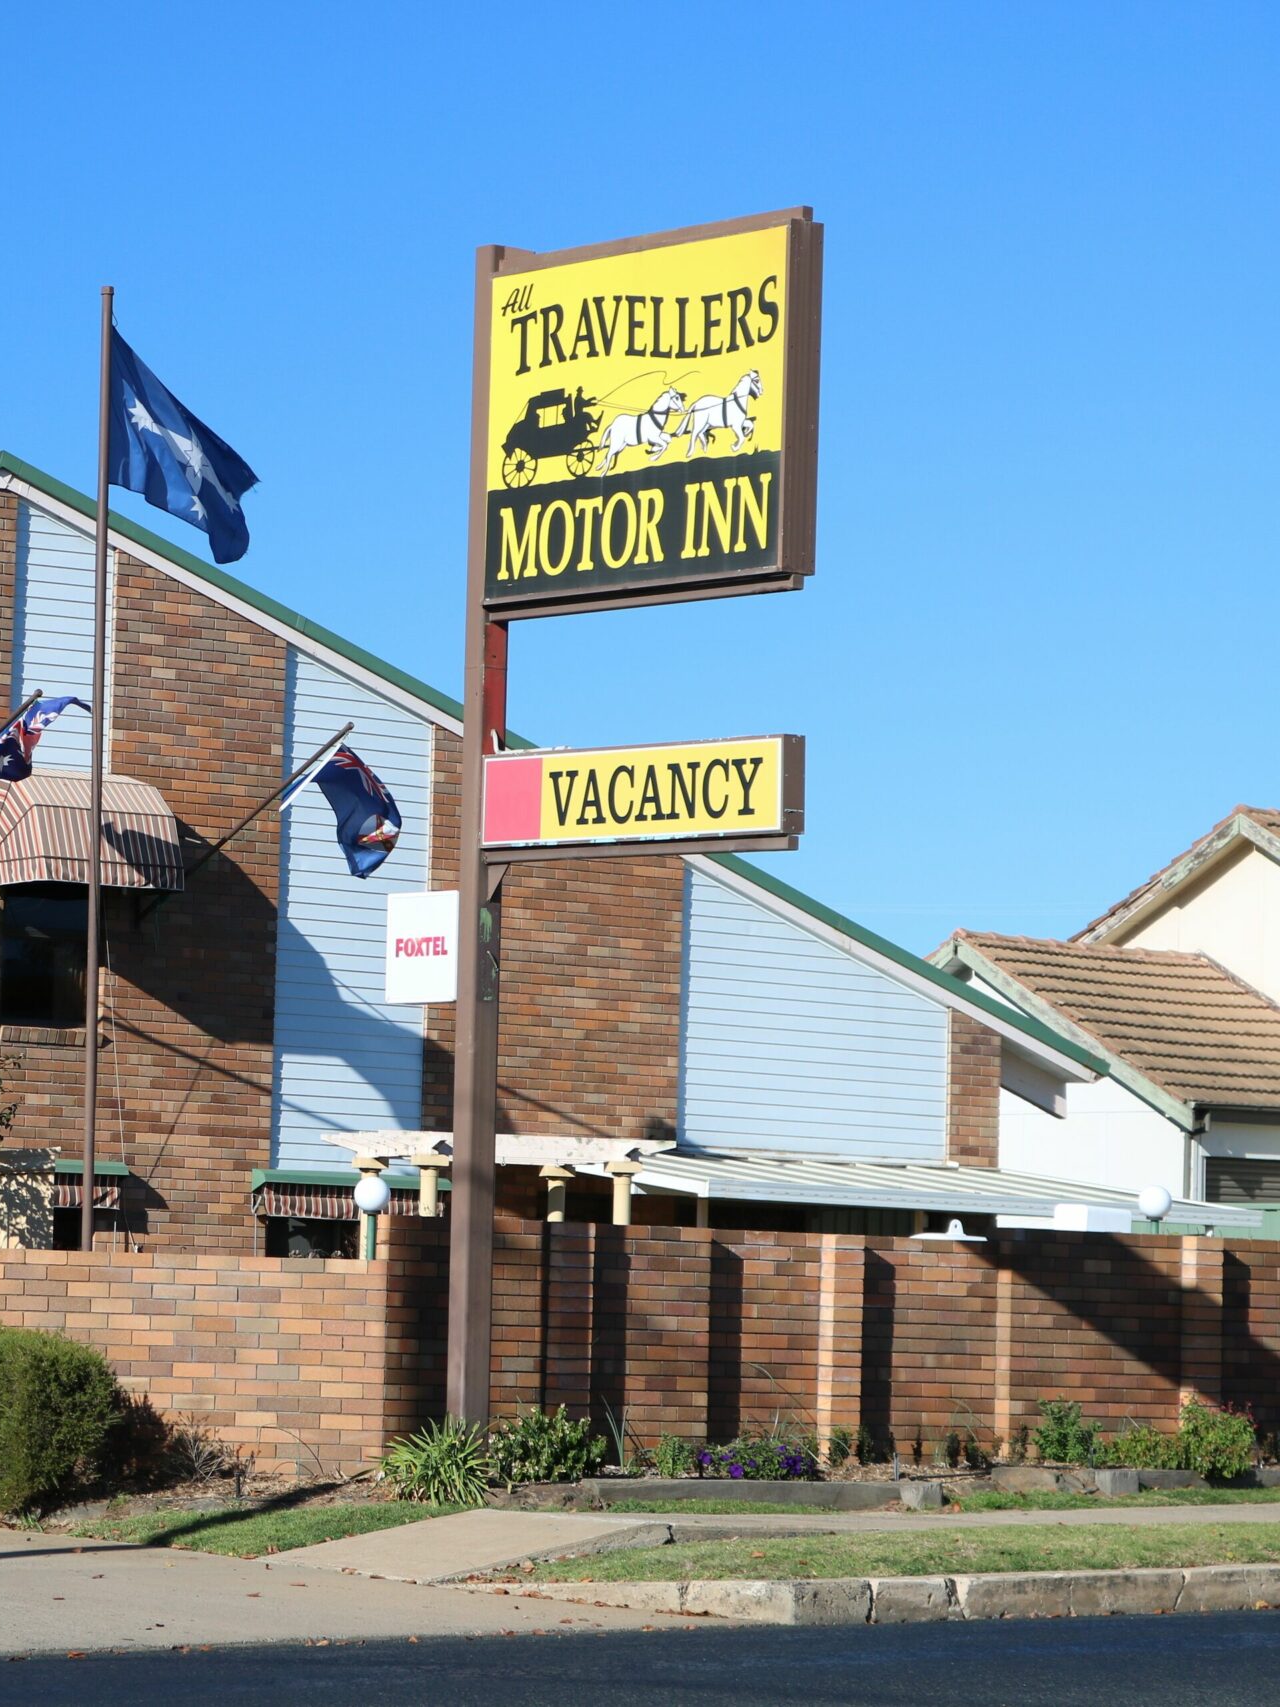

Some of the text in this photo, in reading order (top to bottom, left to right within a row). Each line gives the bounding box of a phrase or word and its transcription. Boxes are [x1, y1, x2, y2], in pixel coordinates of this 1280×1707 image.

[501, 283, 534, 317] All
[510, 275, 780, 377] TRAVELLERS
[497, 472, 772, 581] MOTOR INN
[549, 757, 764, 827] VACANCY
[395, 936, 448, 958] FOXTEL
